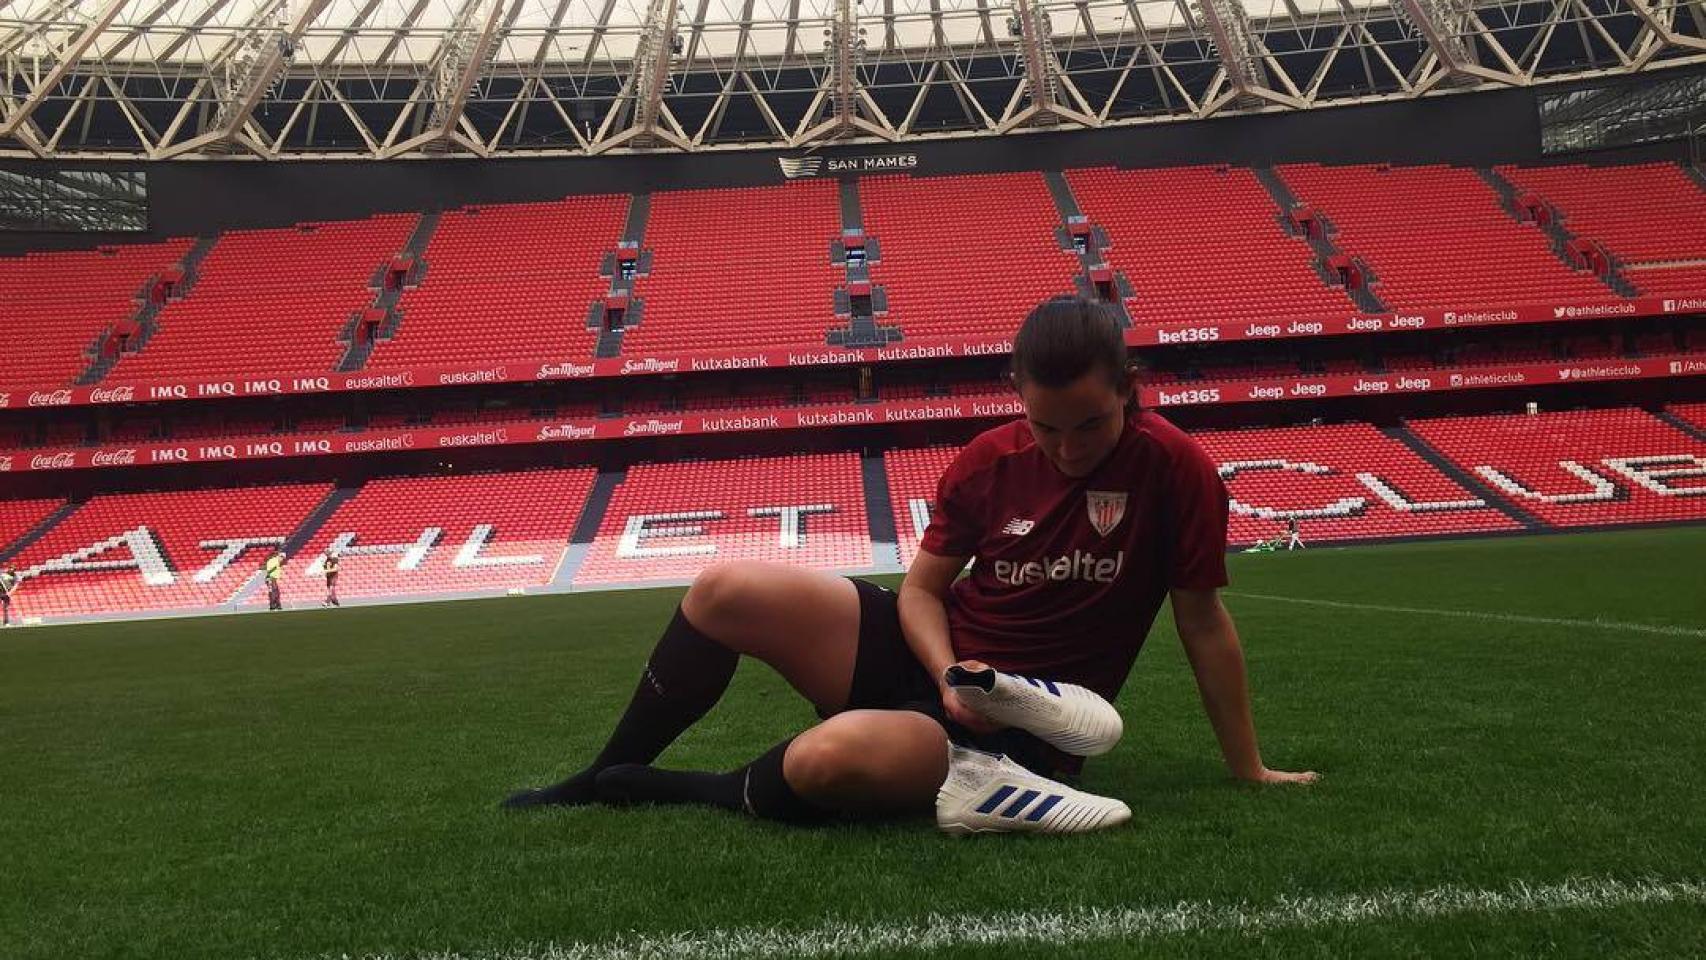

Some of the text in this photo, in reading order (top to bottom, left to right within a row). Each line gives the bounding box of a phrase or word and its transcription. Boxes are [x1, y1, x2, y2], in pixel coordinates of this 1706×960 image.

[828, 155, 918, 170] SAN MAMES
[1457, 310, 1518, 323] athleticclub
[1566, 303, 1636, 317] @athleticclub
[1158, 315, 1425, 343] bet365 Jeep Jeep Jeep Jeep
[150, 384, 189, 398] IMQ
[198, 381, 236, 396] IMQ
[244, 379, 282, 394] IMQ
[293, 378, 329, 391] IMQ
[345, 375, 402, 389] euskaltel
[439, 369, 496, 385] euskaltel
[691, 354, 768, 371] kutxabank
[789, 349, 864, 366] kutxabank
[877, 343, 953, 360] kutxabank
[963, 339, 1013, 356] kutxab
[1464, 372, 1525, 385] athleticclub
[1159, 377, 1430, 405] bet365 Jeep Jeep Jeep Jeep
[151, 448, 190, 462] IMQ
[199, 445, 237, 459] IMQ
[245, 442, 284, 456] IMQ
[294, 440, 332, 453] IMQ
[345, 437, 402, 452] euskaltel
[439, 431, 496, 446] euskaltel
[702, 415, 779, 431] kutxabank
[797, 409, 874, 425] kutxabank
[885, 404, 962, 421] kutxabank
[972, 400, 1025, 415] kutxab
[994, 548, 1124, 587] euskaltel
